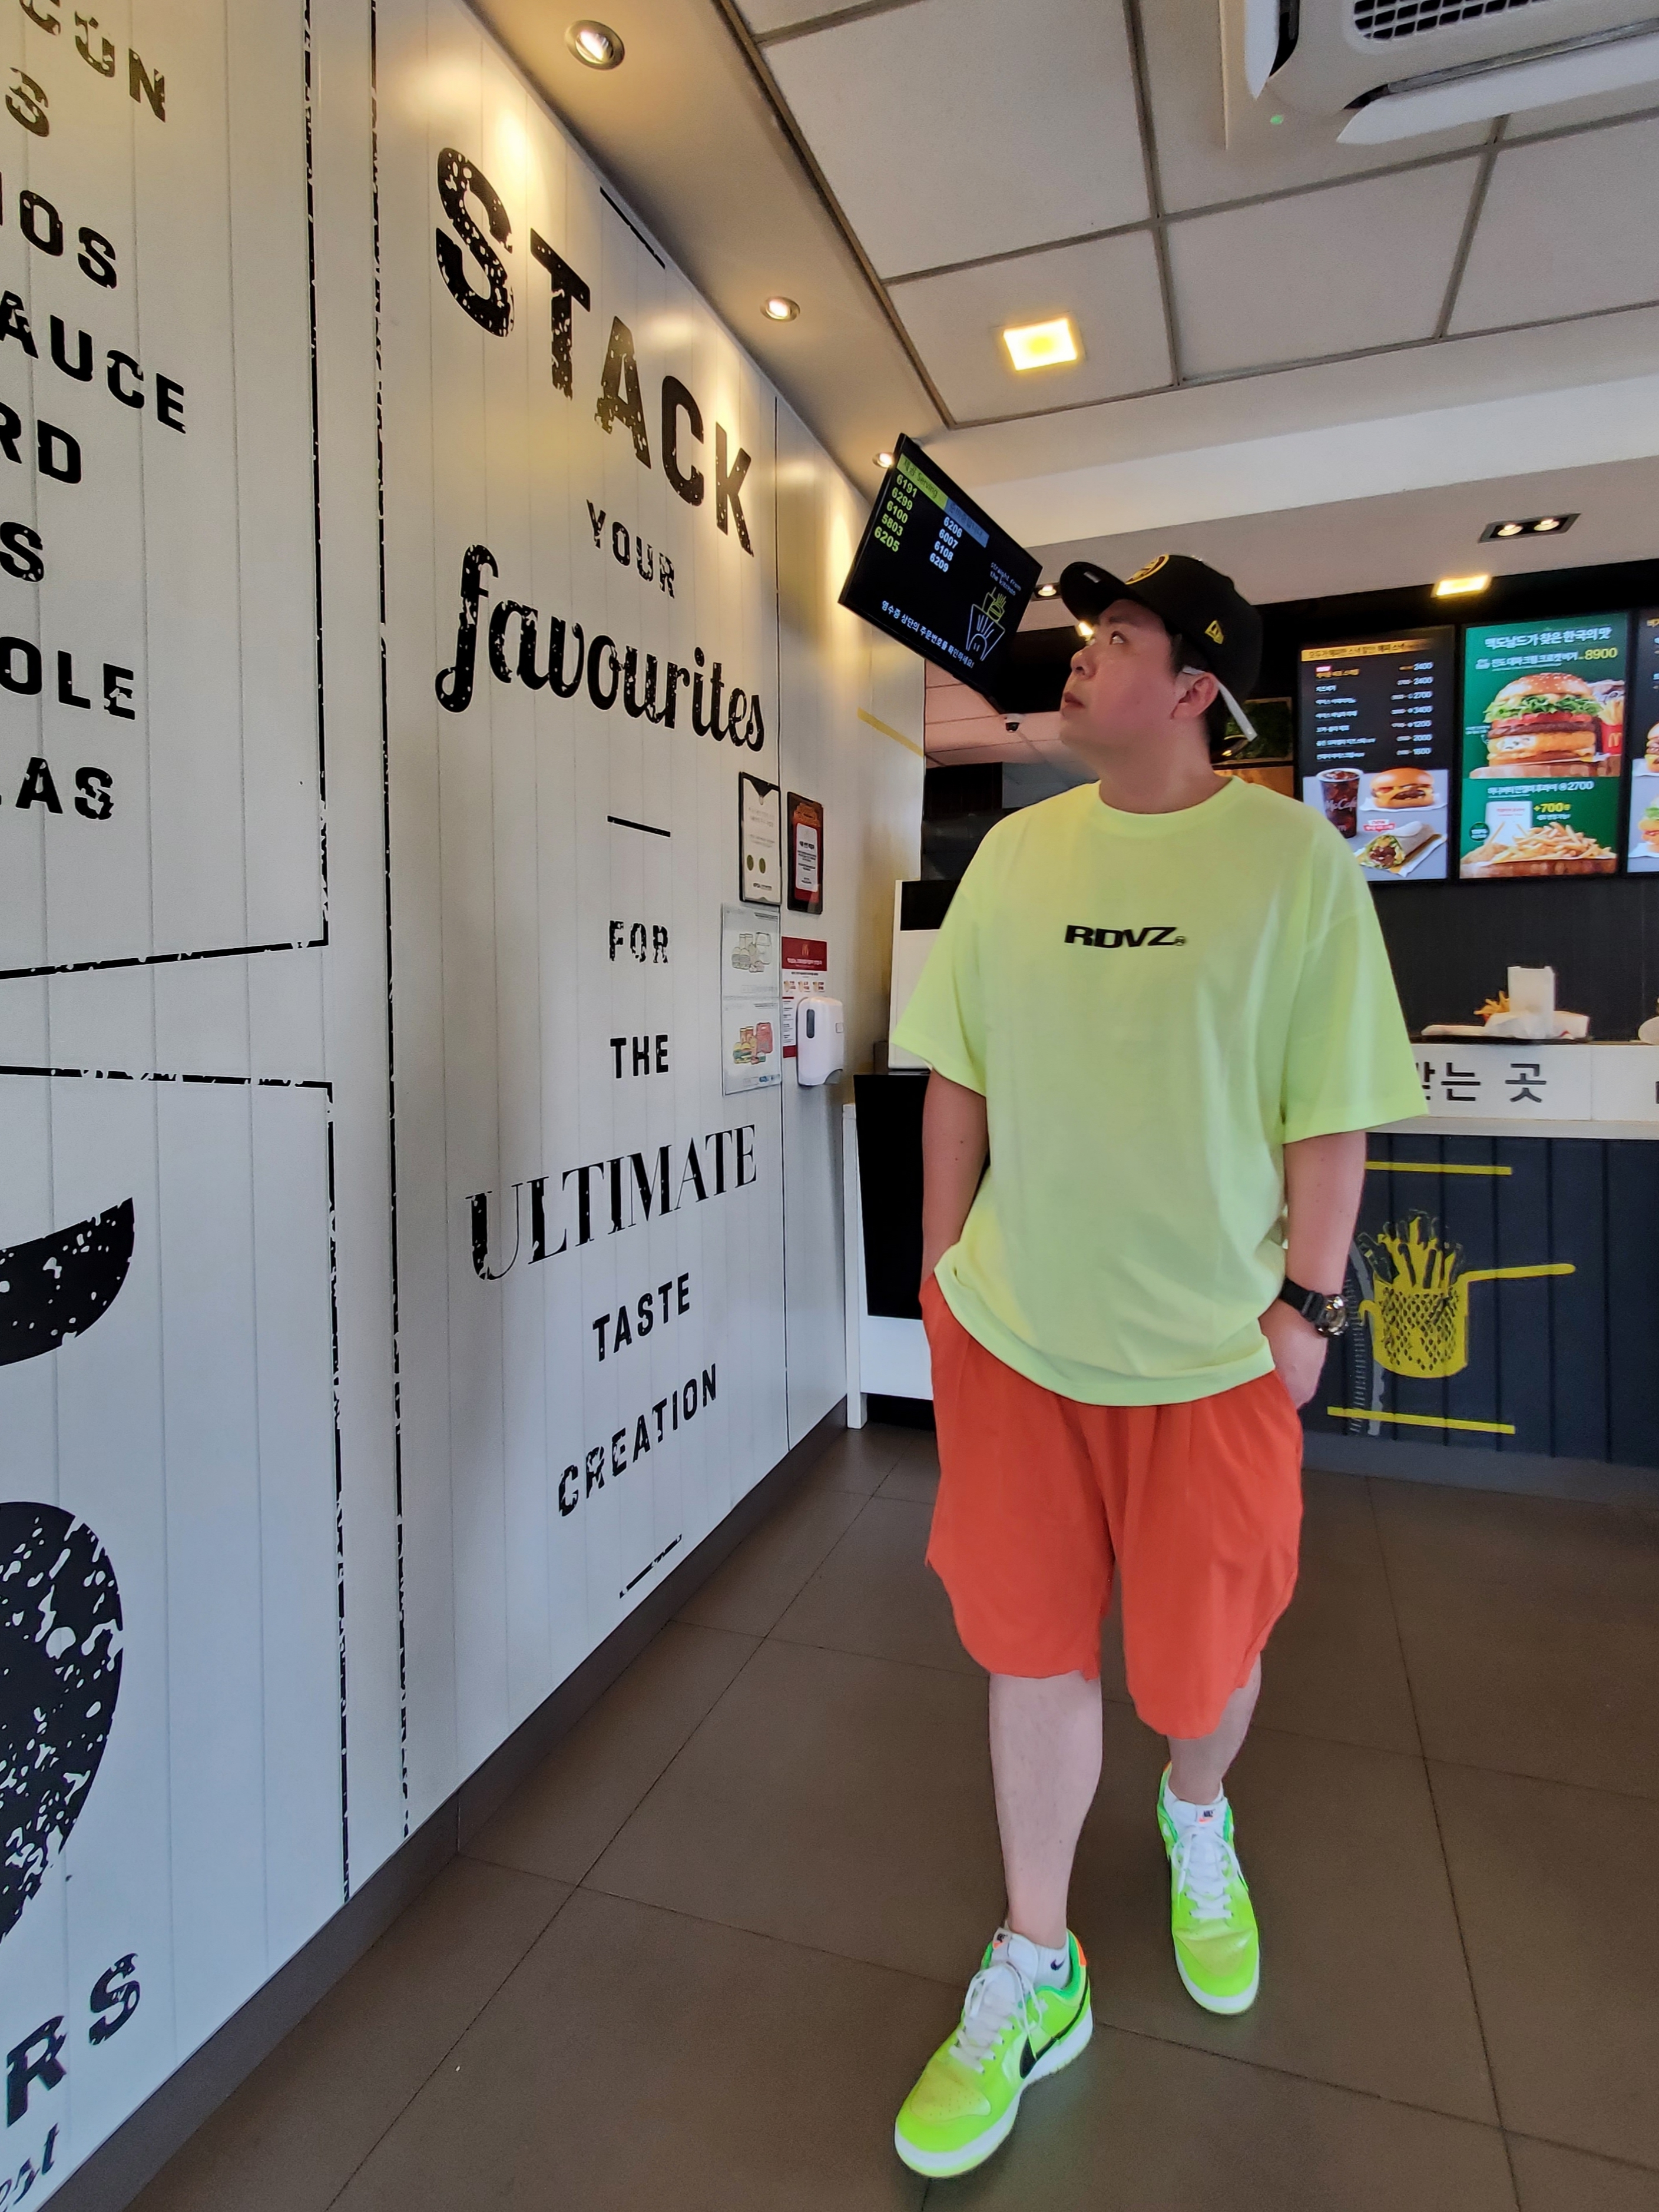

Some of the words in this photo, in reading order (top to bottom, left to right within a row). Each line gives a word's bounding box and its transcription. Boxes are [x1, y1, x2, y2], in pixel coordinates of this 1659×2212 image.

[0, 172, 117, 289] OS
[435, 148, 754, 558] STACK
[892, 487, 913, 511] 6299
[897, 474, 917, 498] 6191
[917, 473, 938, 499] Serving
[882, 513, 903, 537] 5803
[886, 501, 908, 524] 6100
[943, 516, 962, 538] 6206
[586, 499, 675, 599] YOUR
[875, 526, 900, 552] 6205
[934, 541, 953, 561] 6108
[939, 529, 958, 549] 6007
[929, 552, 949, 572] 6209
[882, 600, 900, 619] 영수증
[901, 614, 920, 632] 상단의
[435, 544, 764, 753] favourites
[1585, 647, 1618, 660] 8900
[0, 636, 135, 720] OLE
[0, 757, 114, 820] AS
[609, 920, 669, 964] FOR
[610, 1034, 669, 1079] THE
[1505, 1063, 1547, 1103] 곳
[465, 1124, 757, 1281] ULTIMATE
[592, 1272, 690, 1362] TASTE
[558, 1363, 717, 1518] CREATION
